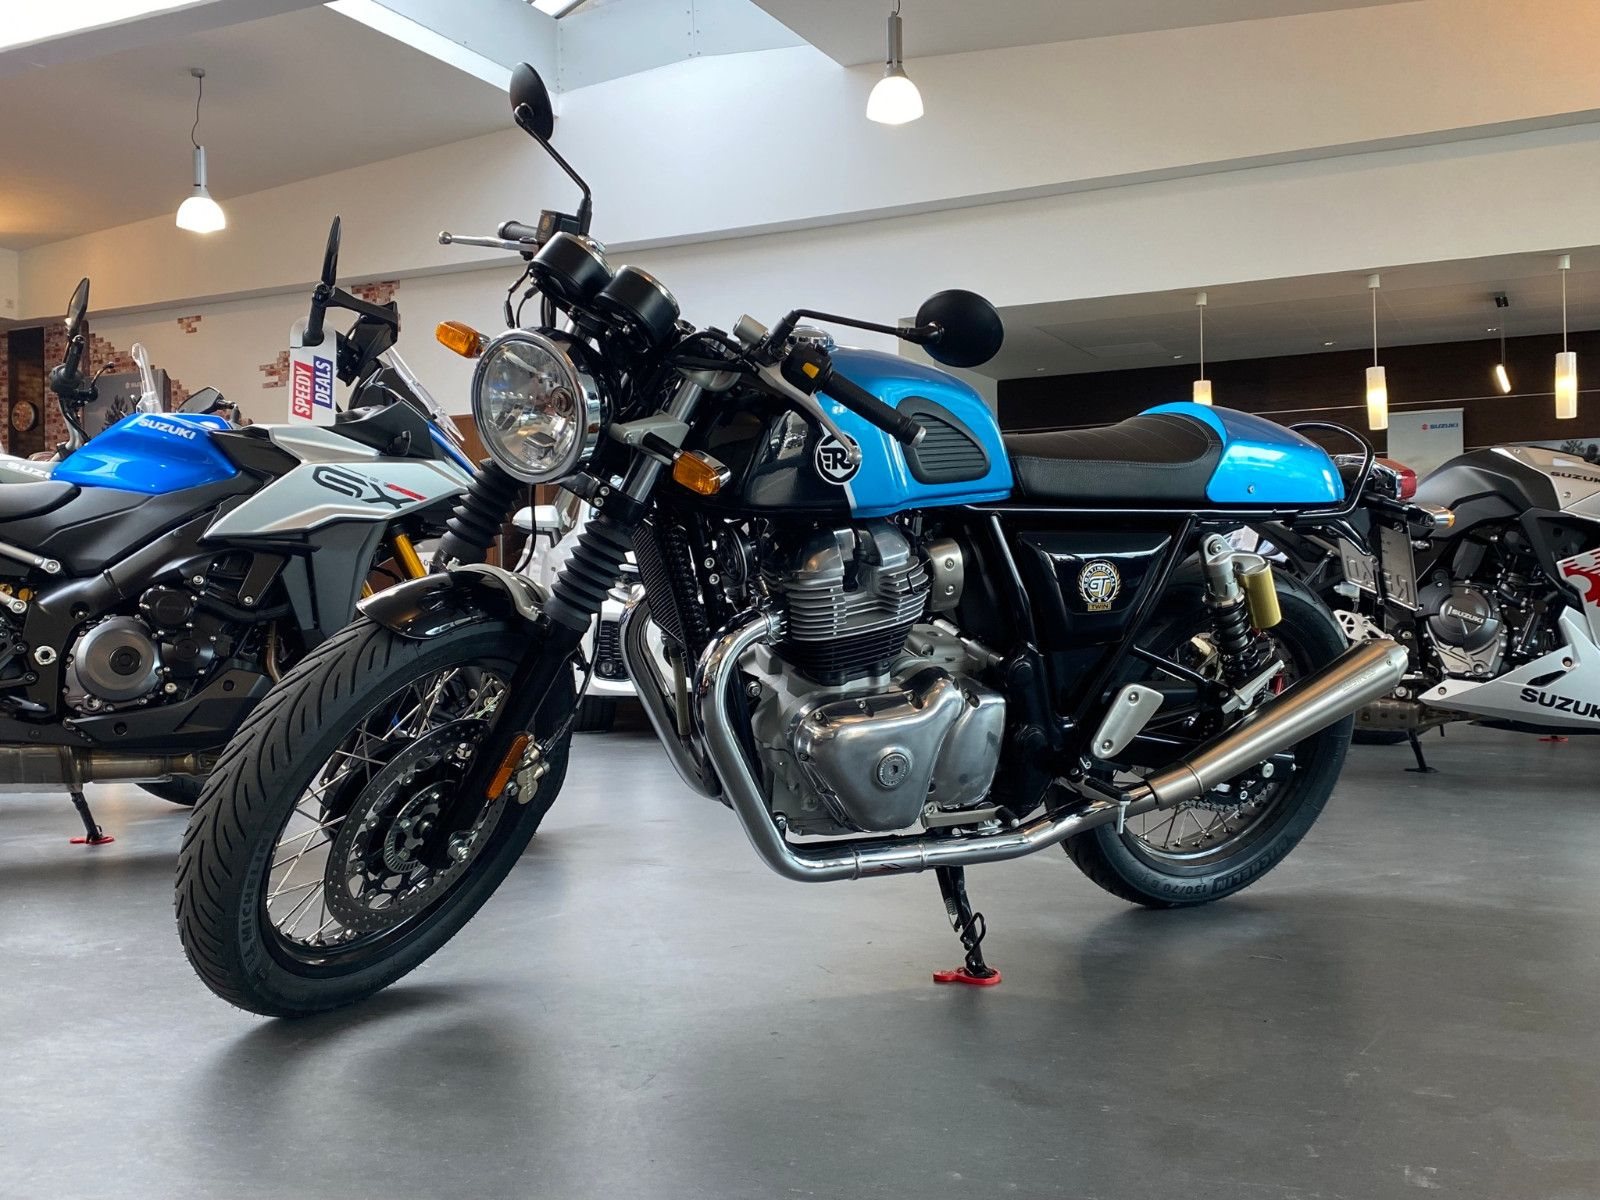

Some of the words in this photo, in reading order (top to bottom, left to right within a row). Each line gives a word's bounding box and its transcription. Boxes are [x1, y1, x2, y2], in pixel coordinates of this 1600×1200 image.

[295, 365, 311, 416] SPEEDY
[315, 360, 332, 404] DEALS
[138, 418, 197, 440] SUZUKI
[1088, 575, 1111, 598] GT
[1451, 608, 1485, 624] SUZUKI
[1213, 838, 1289, 893] MICHELIN
[1163, 882, 1207, 895] 130/70
